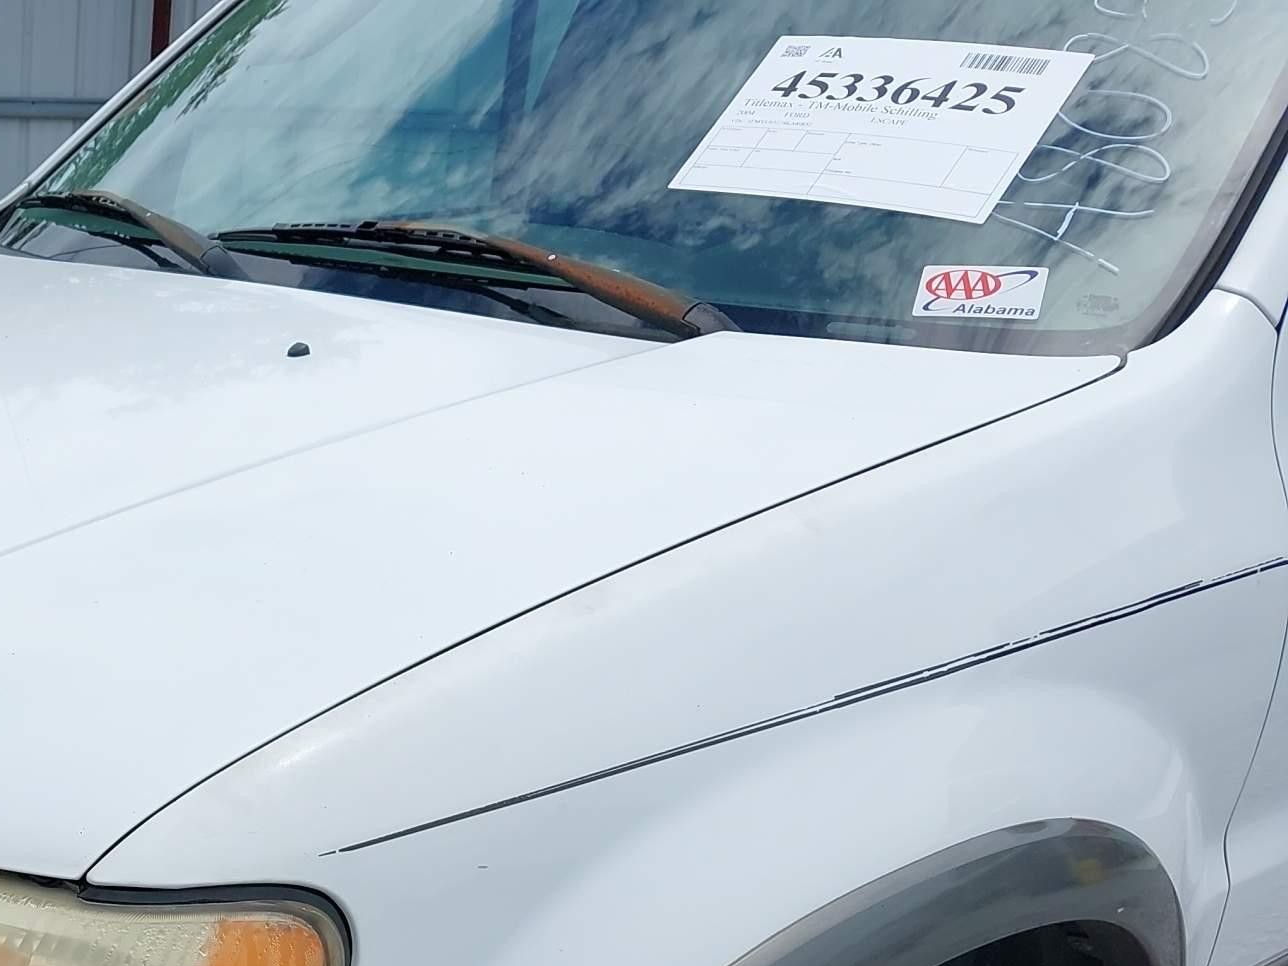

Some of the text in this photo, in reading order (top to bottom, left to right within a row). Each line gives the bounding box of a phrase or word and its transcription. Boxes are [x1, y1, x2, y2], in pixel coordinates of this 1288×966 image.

[771, 69, 1025, 115] 45336425
[744, 98, 793, 109] Titlemax
[808, 101, 879, 113] TM-Mobile
[881, 104, 938, 120] Schilling
[934, 270, 998, 299] AAA
[952, 303, 1036, 317] Alabama
